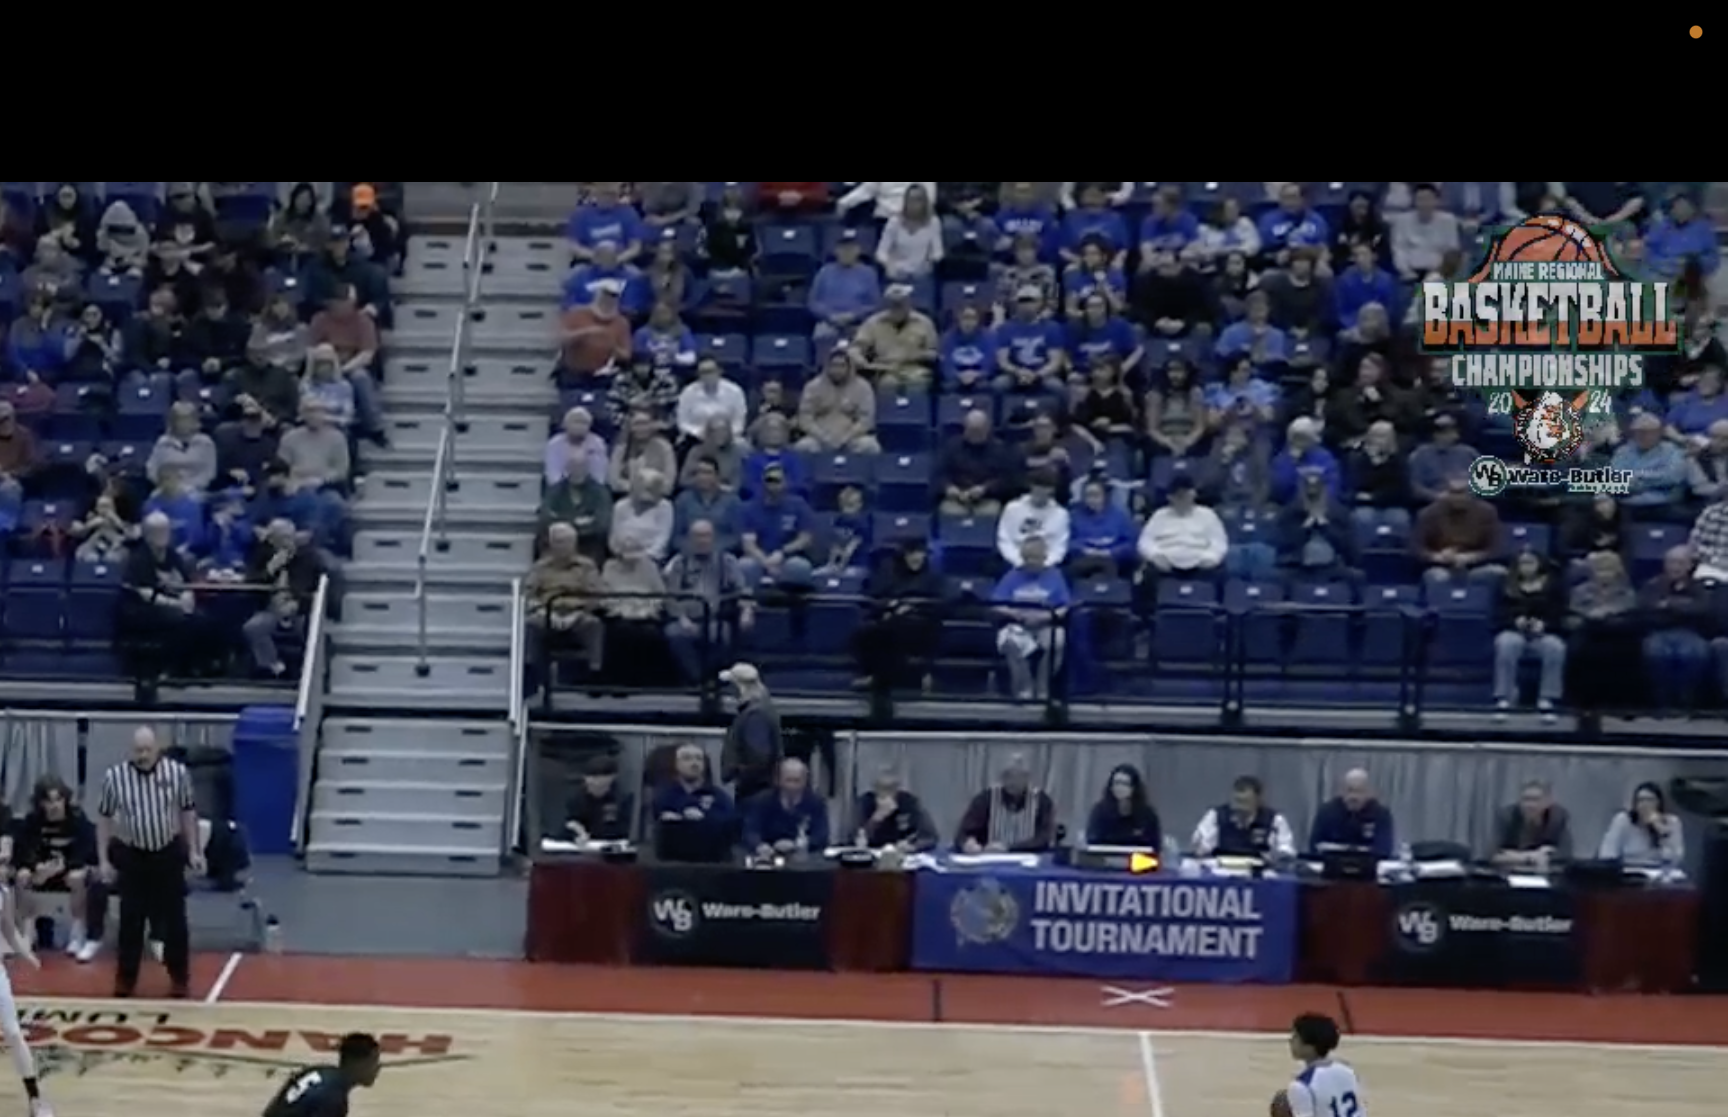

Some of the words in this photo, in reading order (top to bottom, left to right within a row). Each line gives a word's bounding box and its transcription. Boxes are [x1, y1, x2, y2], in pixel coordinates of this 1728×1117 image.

[701, 902, 821, 921] Ware-Butler
[1034, 880, 1263, 919] INVITATIONAL
[1030, 919, 1264, 958] TOURNAMENT
